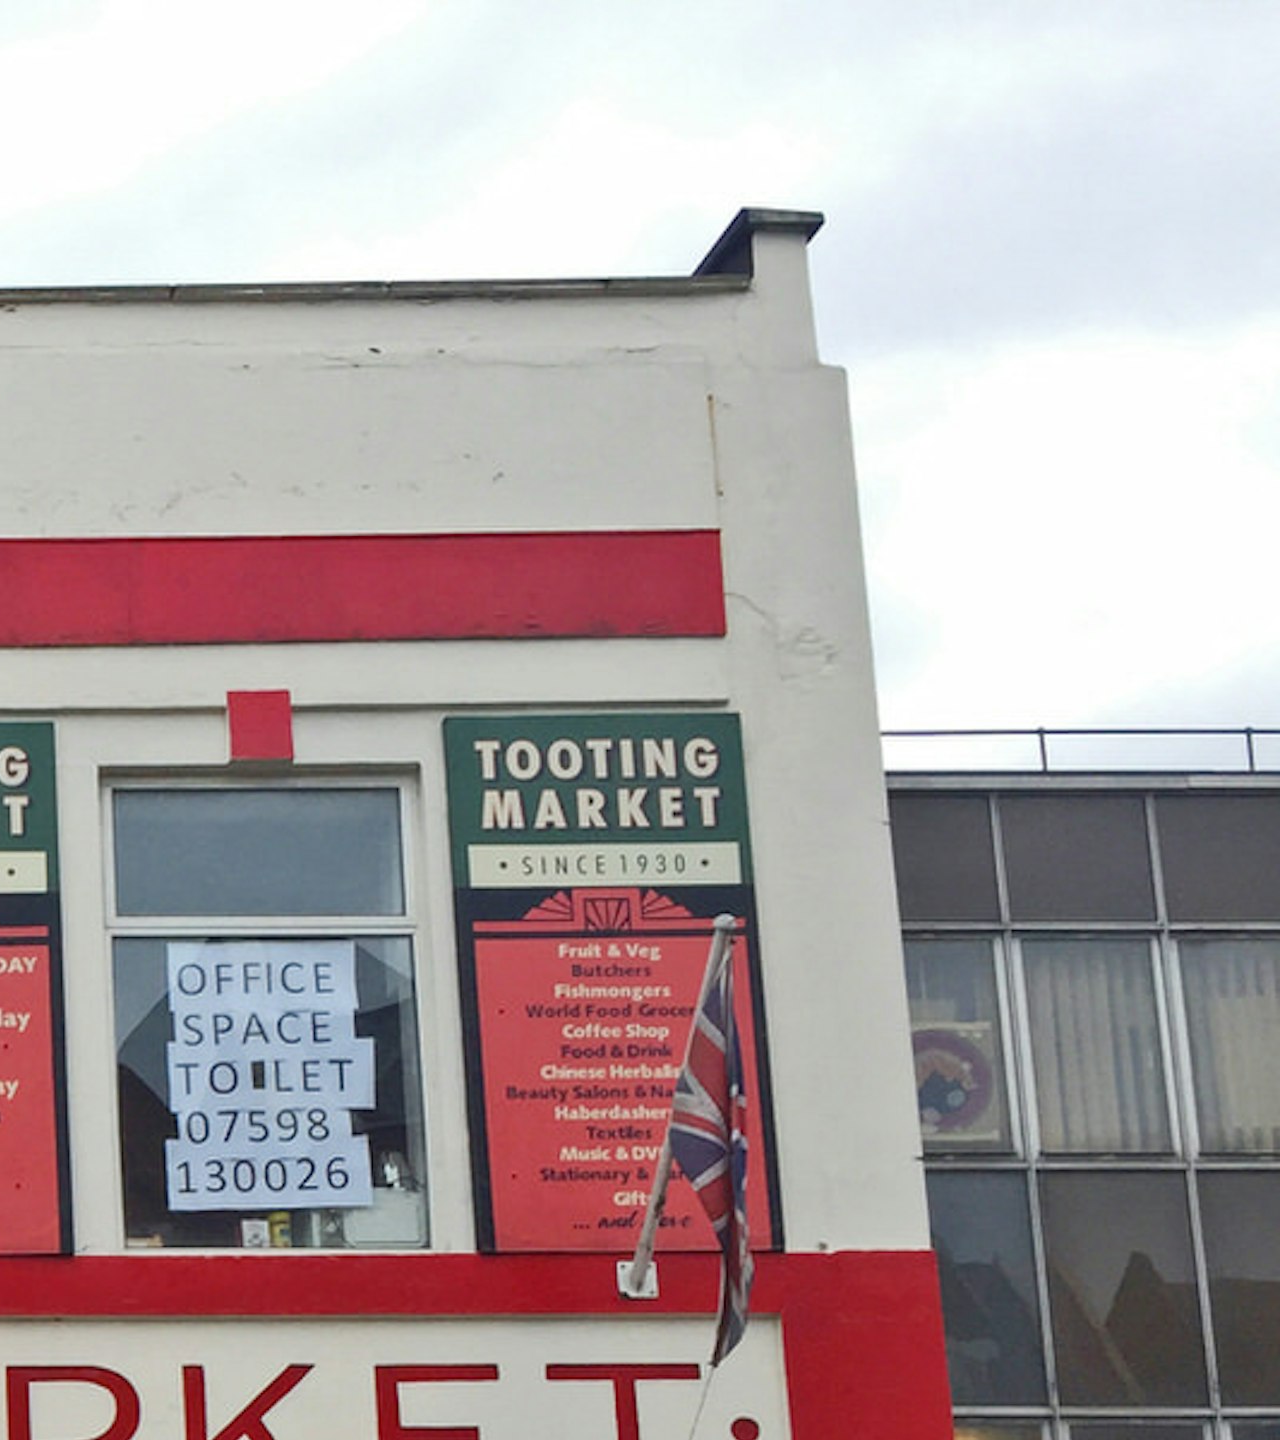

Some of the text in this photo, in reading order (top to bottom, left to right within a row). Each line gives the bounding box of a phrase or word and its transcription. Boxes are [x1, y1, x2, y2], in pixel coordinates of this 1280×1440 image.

[473, 738, 720, 781] TOOTING
[481, 787, 721, 830] MARKET
[521, 854, 686, 875] SINCE 1930
[558, 943, 661, 962] Fruit & Veg
[177, 962, 334, 996] OFFICE
[571, 964, 651, 978] Butchers
[554, 984, 671, 1002] Fishmongers
[525, 1004, 580, 1018] World
[586, 1004, 631, 1018] Food
[183, 1011, 332, 1046] SPACE
[562, 1024, 669, 1042] Coffee Shop
[560, 1045, 672, 1059] Food & Drink
[176, 1059, 354, 1094] TO LET
[540, 1064, 605, 1080] Chinese
[506, 1086, 568, 1102] Beauty
[573, 1085, 628, 1100] Salons
[554, 1105, 672, 1121] Haberdasher
[187, 1108, 330, 1144] 07598
[587, 1126, 652, 1140] Textiles
[559, 1146, 610, 1161] Music
[615, 1146, 629, 1161] &
[177, 1157, 350, 1193] 130026
[613, 1191, 651, 1207] Gift
